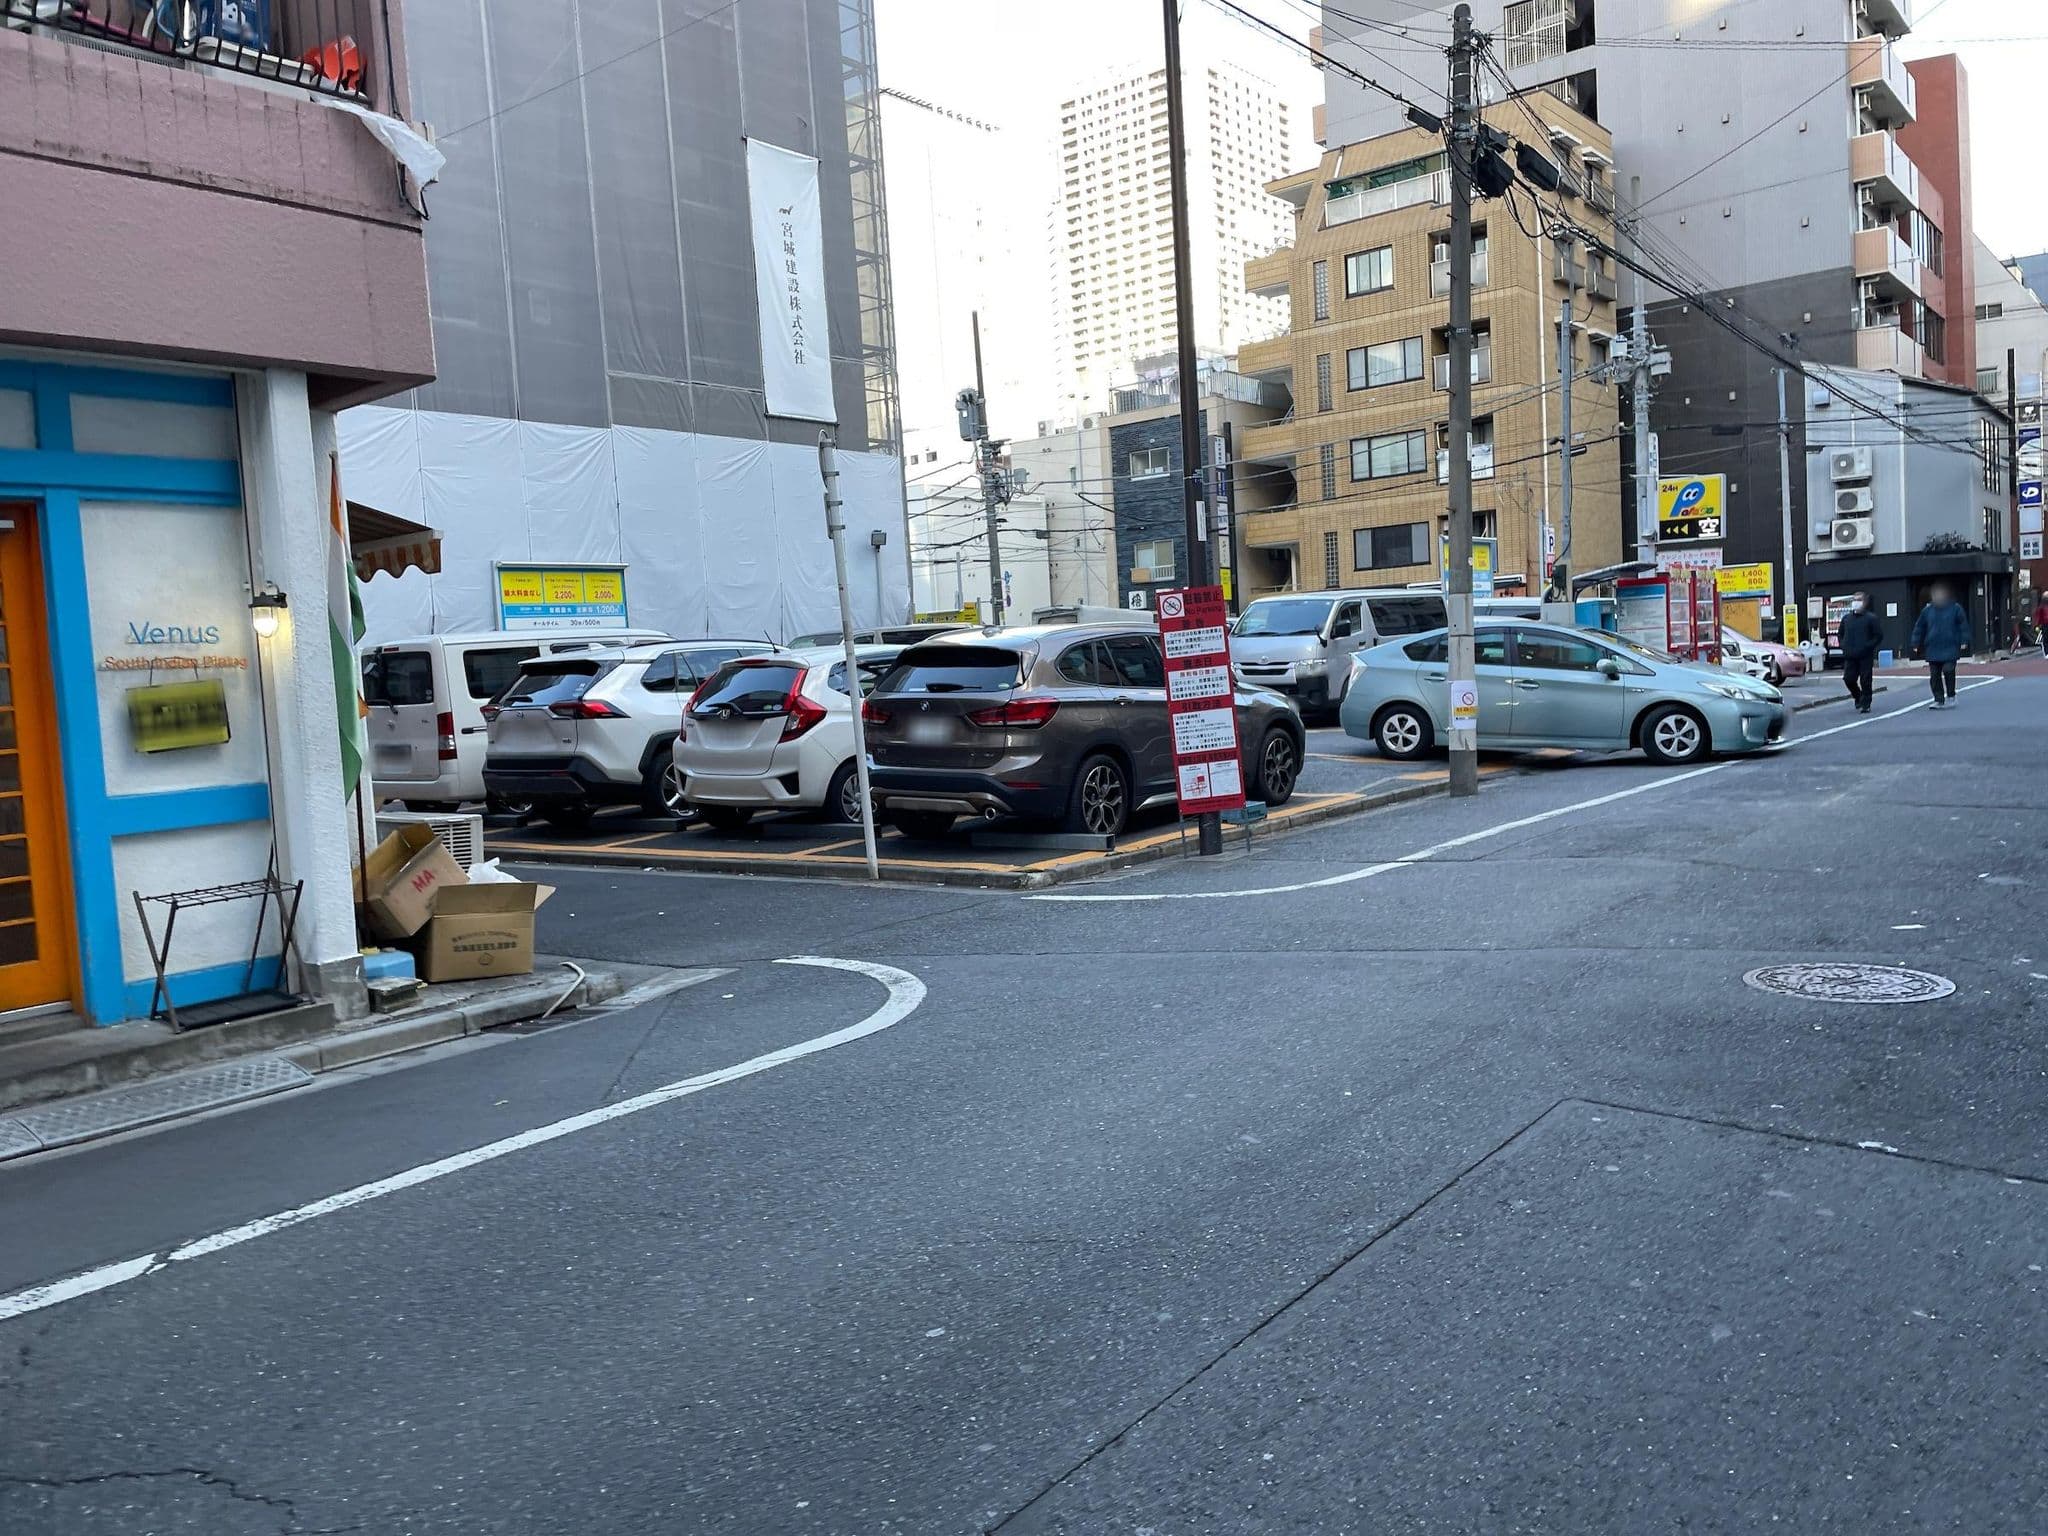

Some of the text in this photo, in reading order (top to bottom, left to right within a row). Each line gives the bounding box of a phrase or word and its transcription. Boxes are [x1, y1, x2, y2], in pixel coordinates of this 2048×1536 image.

[780, 221, 806, 366] 宮城建設株式会社
[1698, 517, 1719, 537] 空
[129, 621, 220, 644] Venus
[104, 655, 248, 670] South Indian Dining
[411, 869, 435, 893] MA
